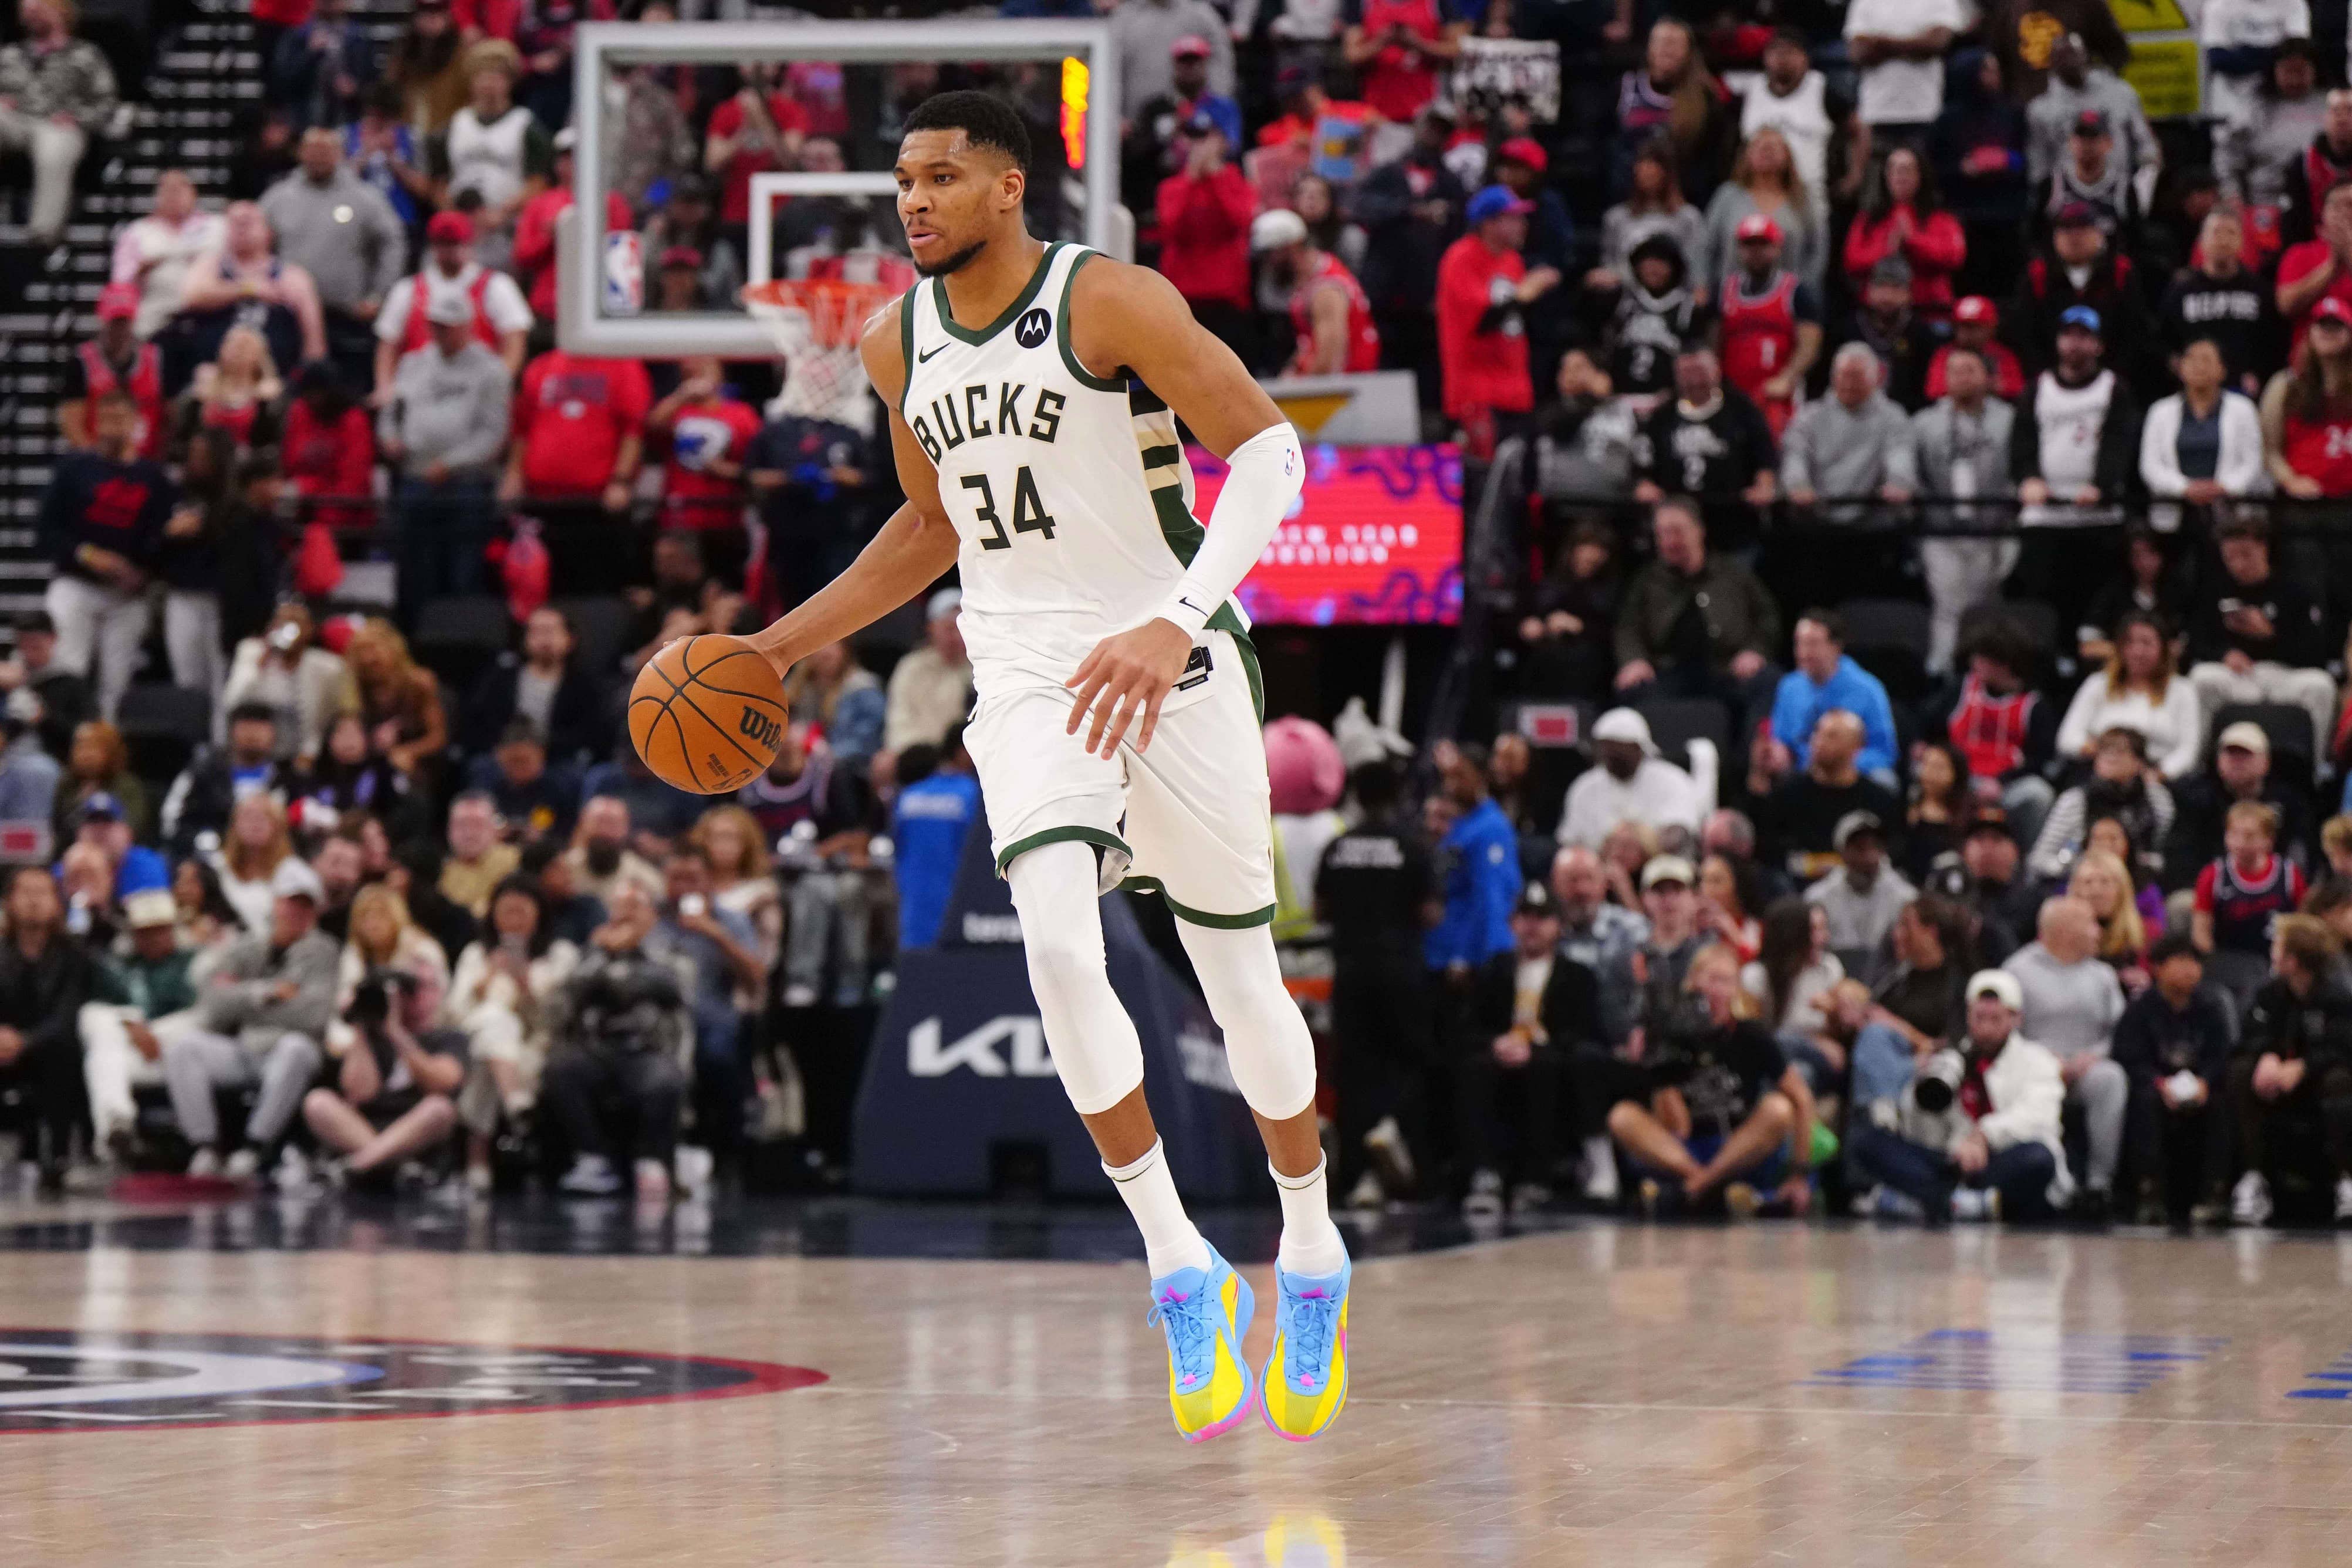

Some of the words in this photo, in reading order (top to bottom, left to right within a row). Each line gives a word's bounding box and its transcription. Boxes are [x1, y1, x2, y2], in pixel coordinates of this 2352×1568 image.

[914, 383, 1066, 465] BUCKS
[960, 466, 1056, 550] 34
[908, 1015, 1056, 1077] KI
